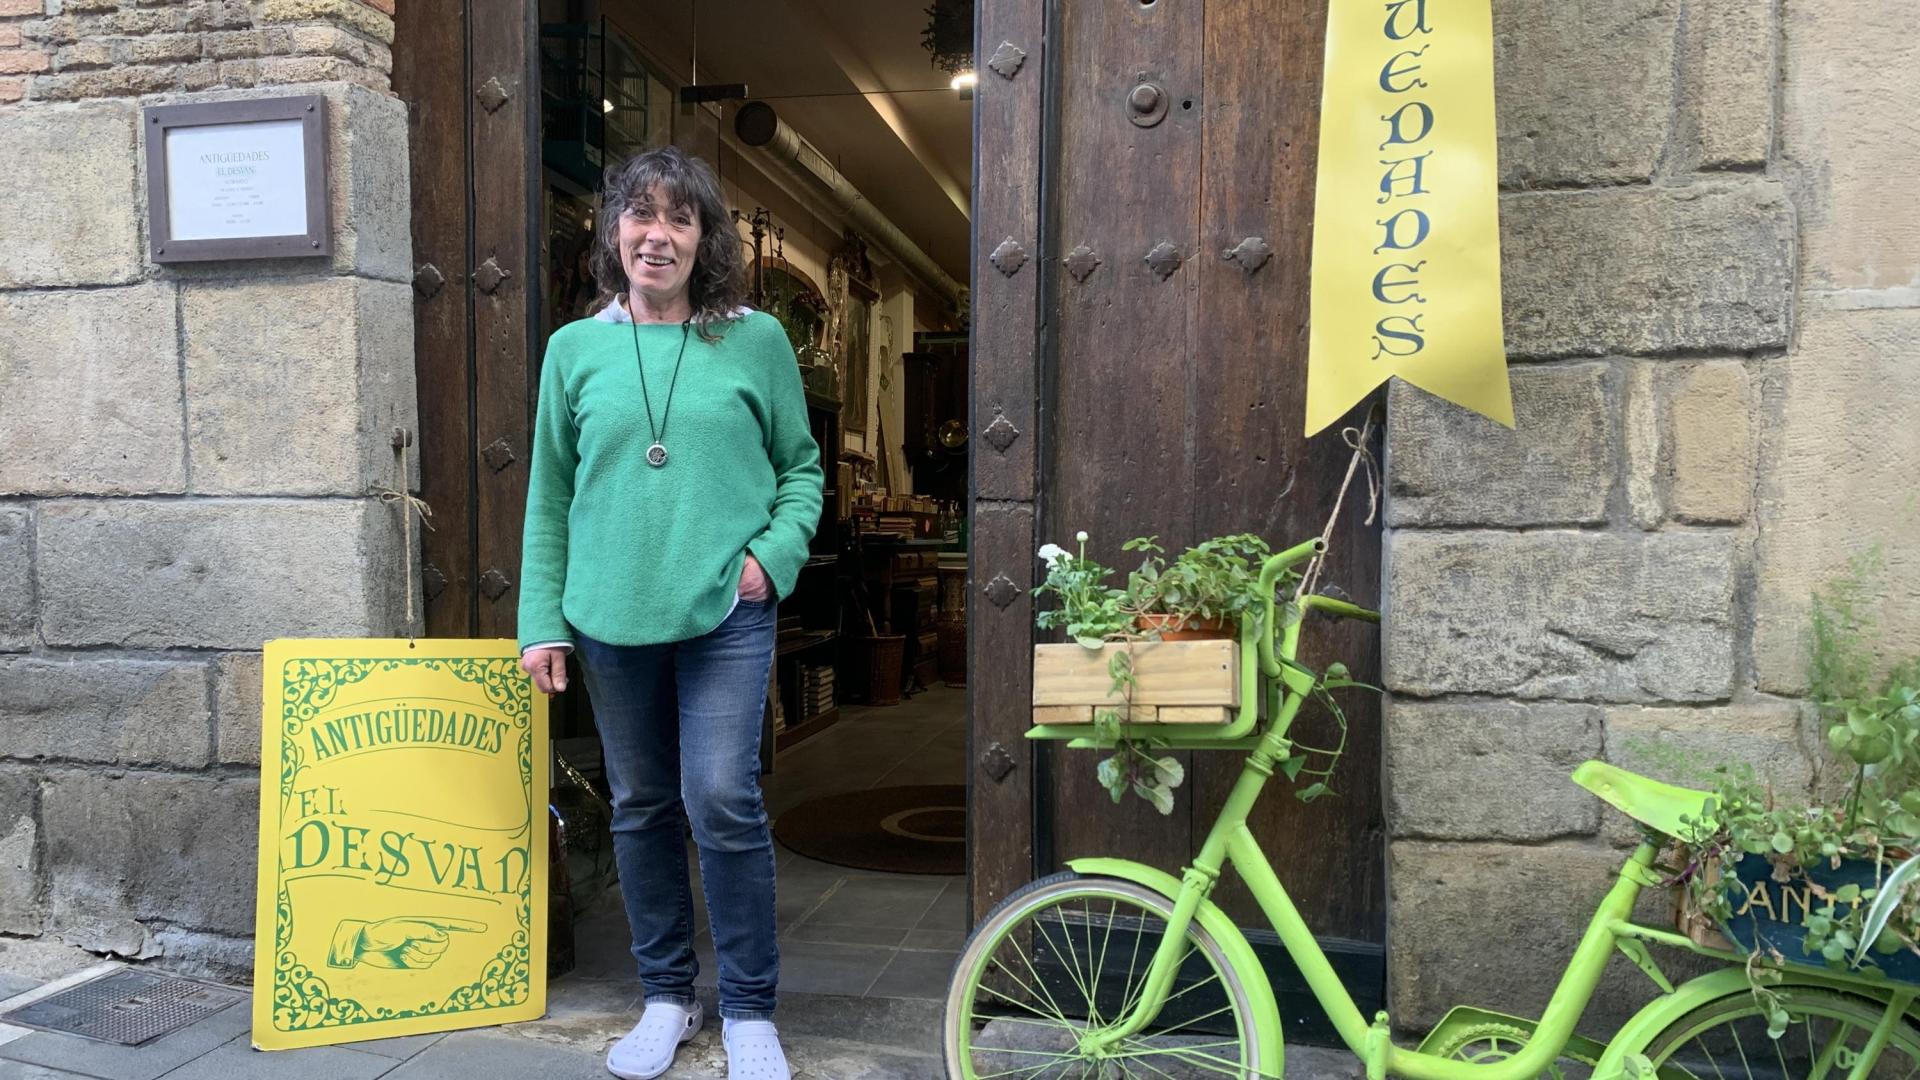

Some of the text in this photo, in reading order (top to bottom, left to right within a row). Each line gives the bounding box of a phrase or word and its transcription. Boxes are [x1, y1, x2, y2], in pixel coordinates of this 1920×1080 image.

[310, 703, 510, 761] ANTIGÜEDADES
[294, 785, 347, 822] EL
[284, 820, 528, 896] DESVAN
